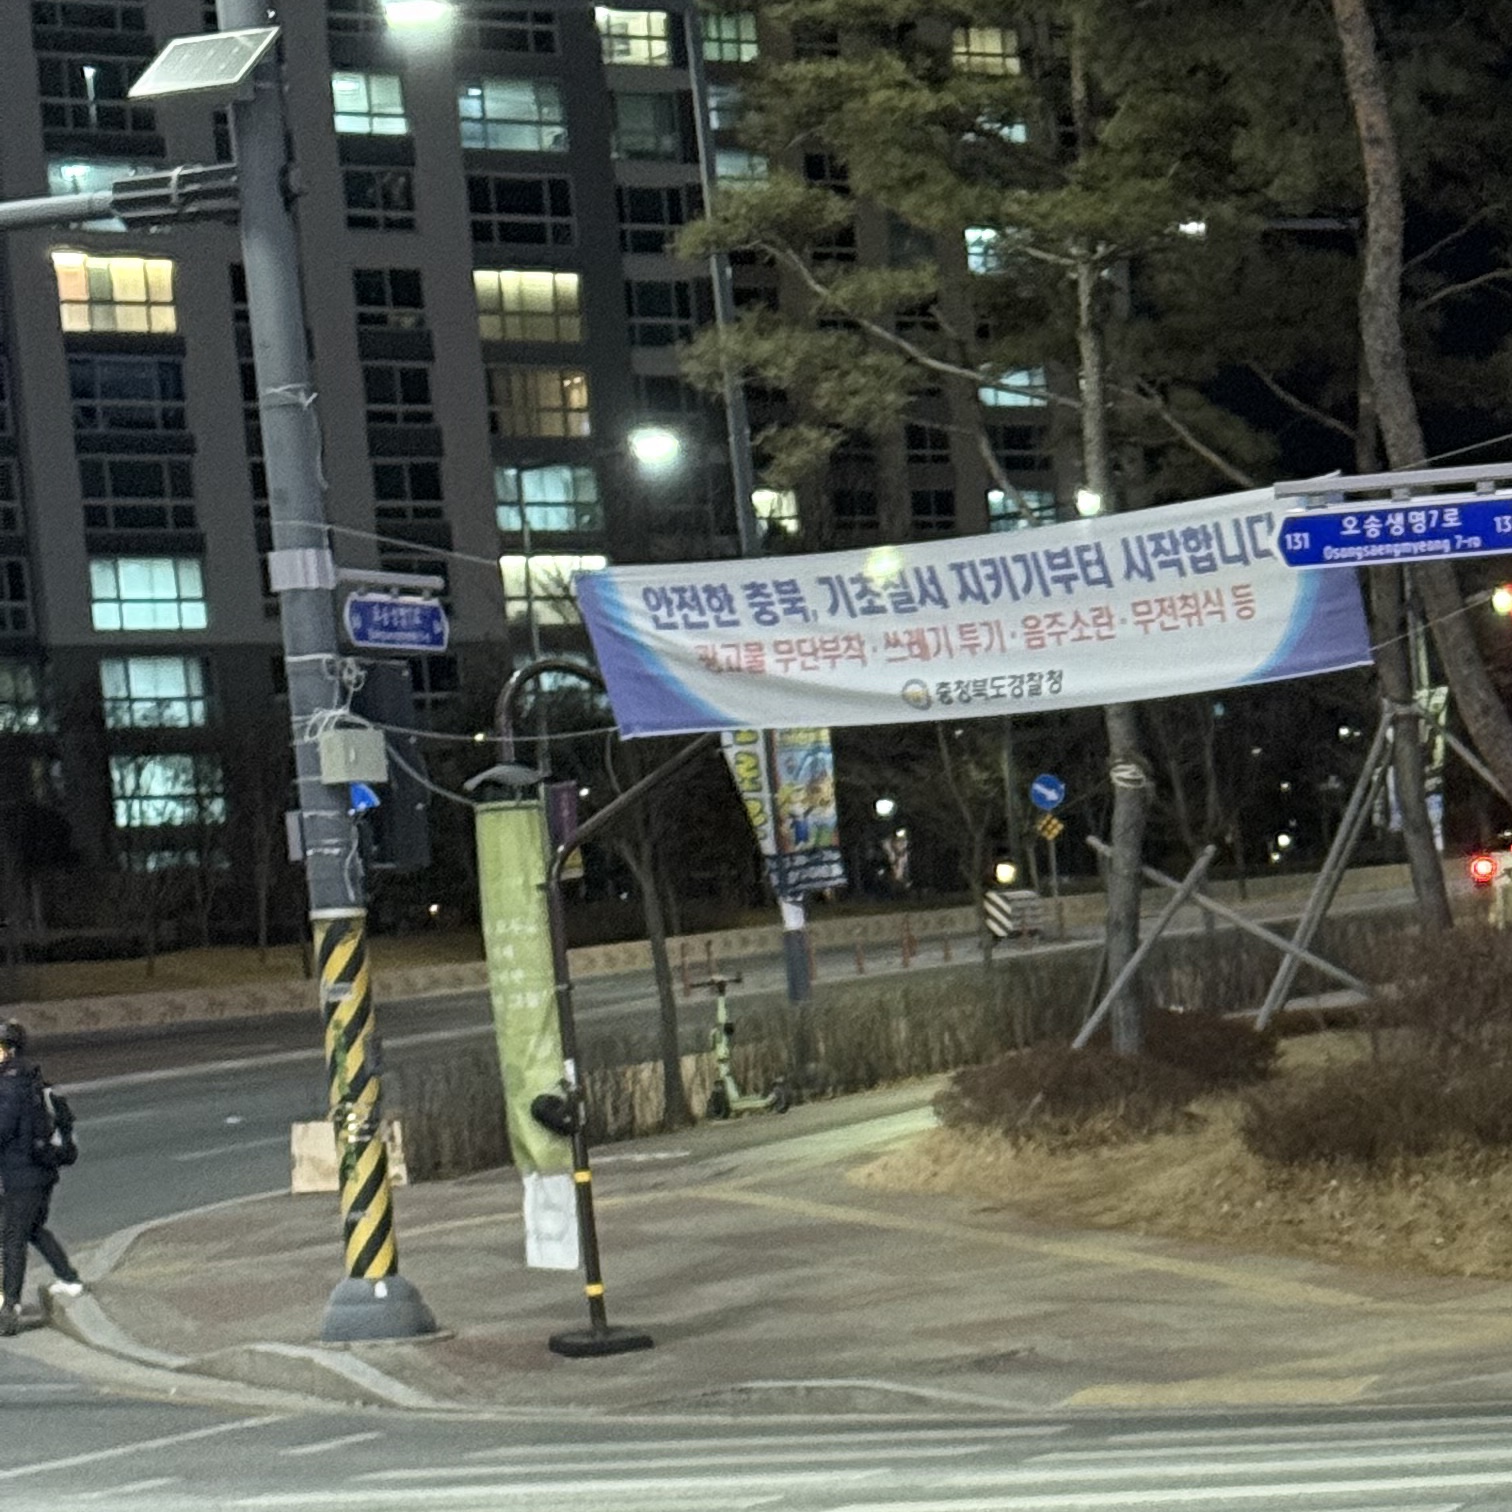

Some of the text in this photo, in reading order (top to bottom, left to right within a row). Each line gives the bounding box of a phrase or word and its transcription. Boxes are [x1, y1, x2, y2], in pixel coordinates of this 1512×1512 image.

[1285, 532, 1310, 550] 131
[1340, 507, 1463, 538] 오송생명7로
[643, 581, 741, 631] 안전한
[817, 564, 949, 619] 기초질서
[951, 541, 1114, 605] 지키기부터
[773, 633, 867, 673] 무단부착
[884, 626, 953, 664] 쓰레기
[957, 619, 1006, 657] 투기
[1021, 605, 1116, 650] 음주소란
[1131, 587, 1227, 635] 무전취식
[1231, 583, 1256, 621] 등
[935, 669, 1063, 706] 충청북도경찰청
